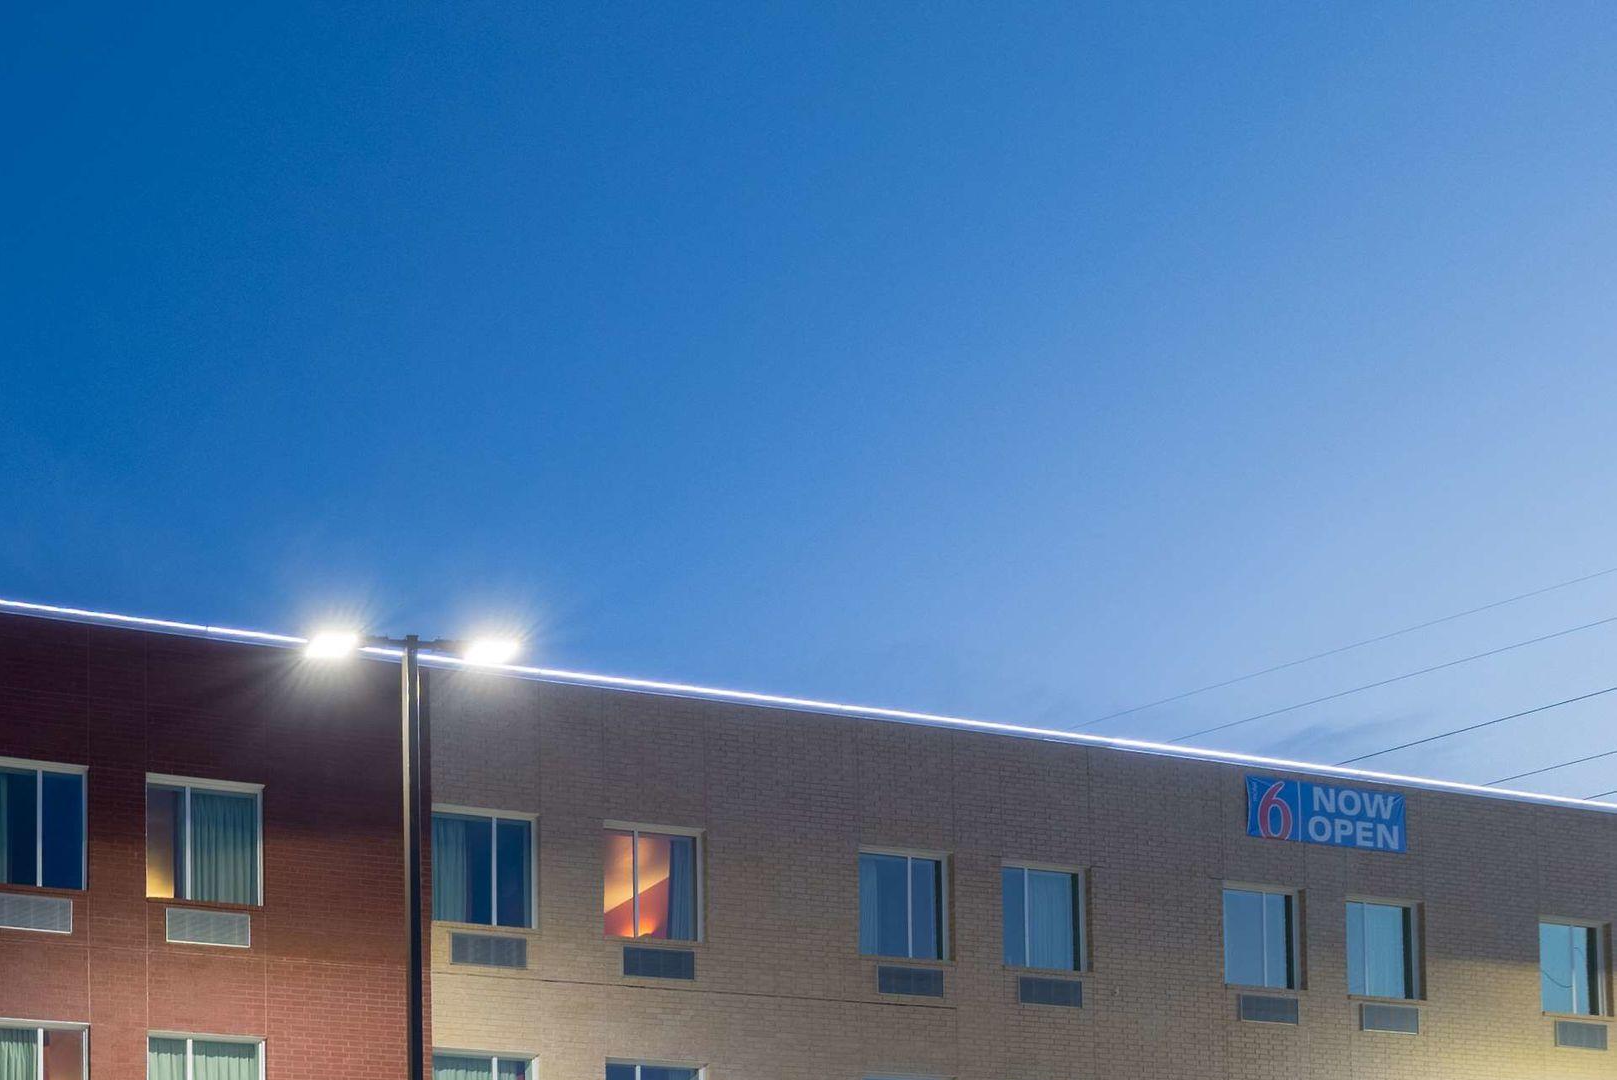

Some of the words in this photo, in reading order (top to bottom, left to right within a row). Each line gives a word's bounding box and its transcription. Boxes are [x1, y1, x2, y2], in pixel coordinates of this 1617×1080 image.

[1257, 780, 1293, 841] 6
[1312, 786, 1395, 820] NOW
[1307, 815, 1400, 850] OPEN
